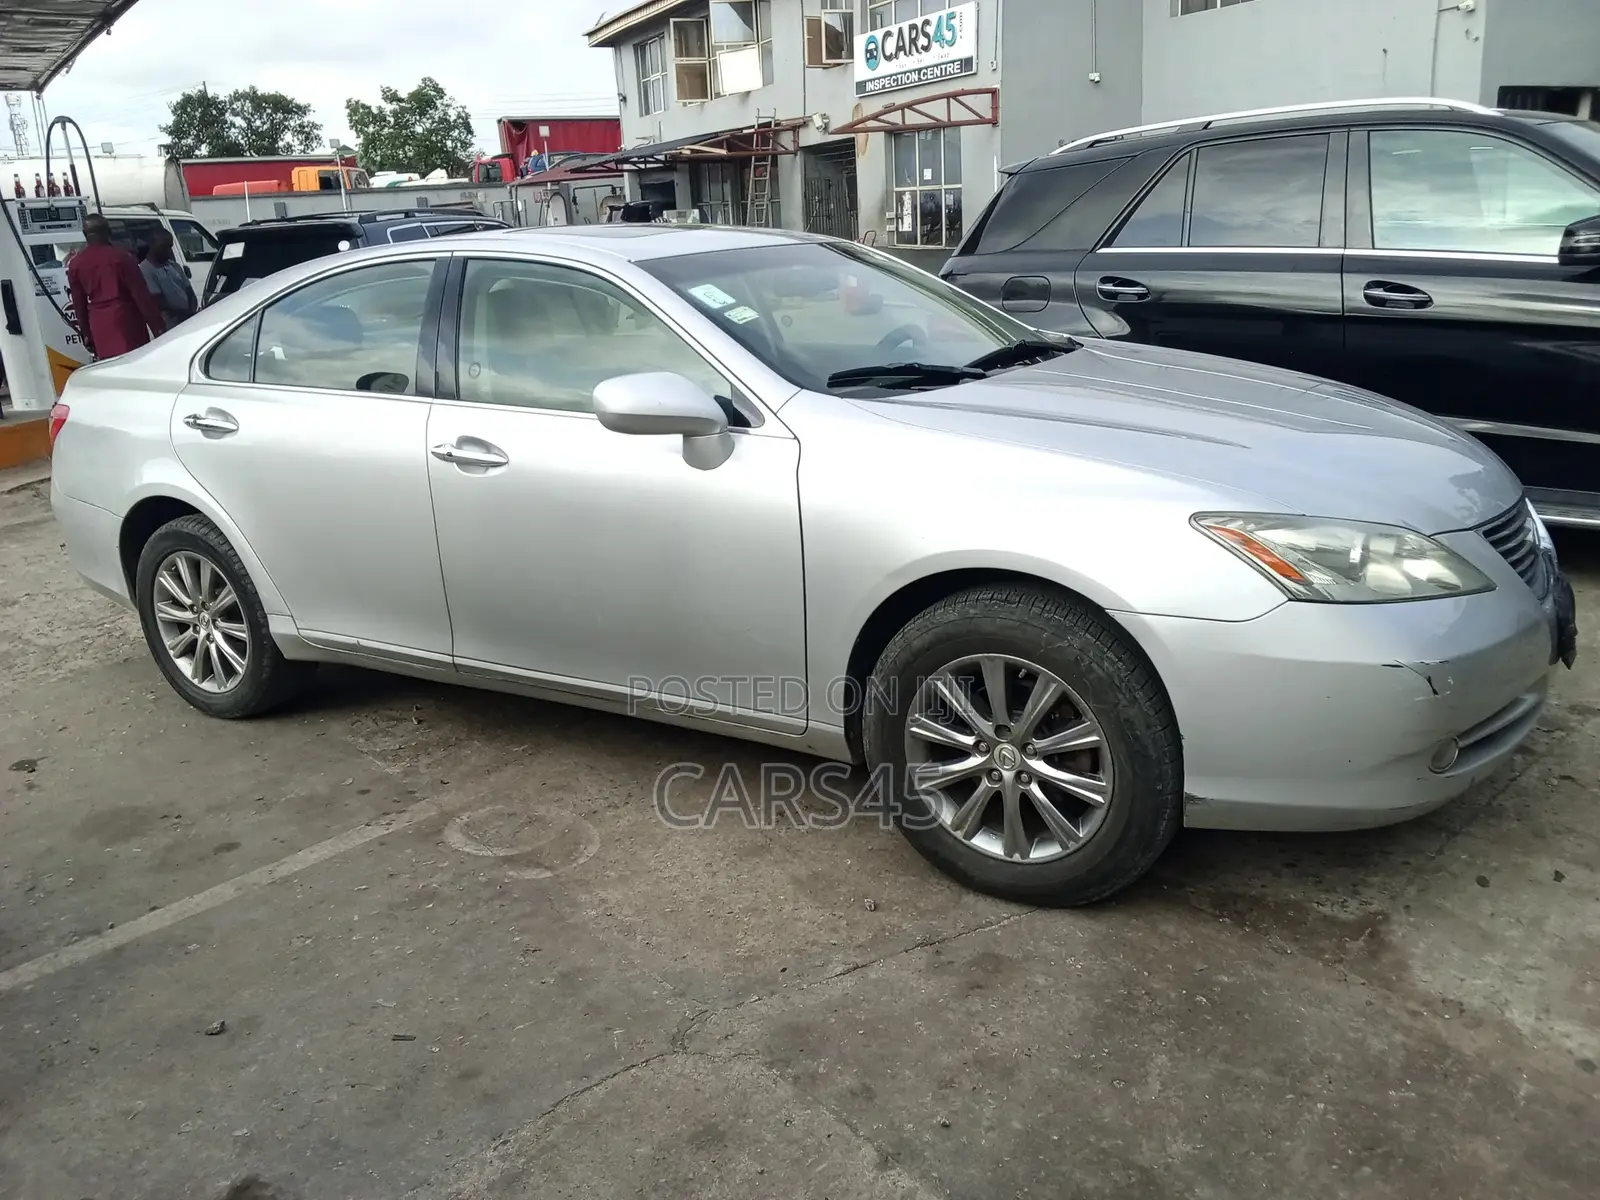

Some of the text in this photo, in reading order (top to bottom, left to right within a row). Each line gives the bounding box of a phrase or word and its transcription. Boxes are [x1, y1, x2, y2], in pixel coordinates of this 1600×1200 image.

[881, 11, 957, 62] CARS45
[866, 60, 961, 92] INSPECTION CENTRE
